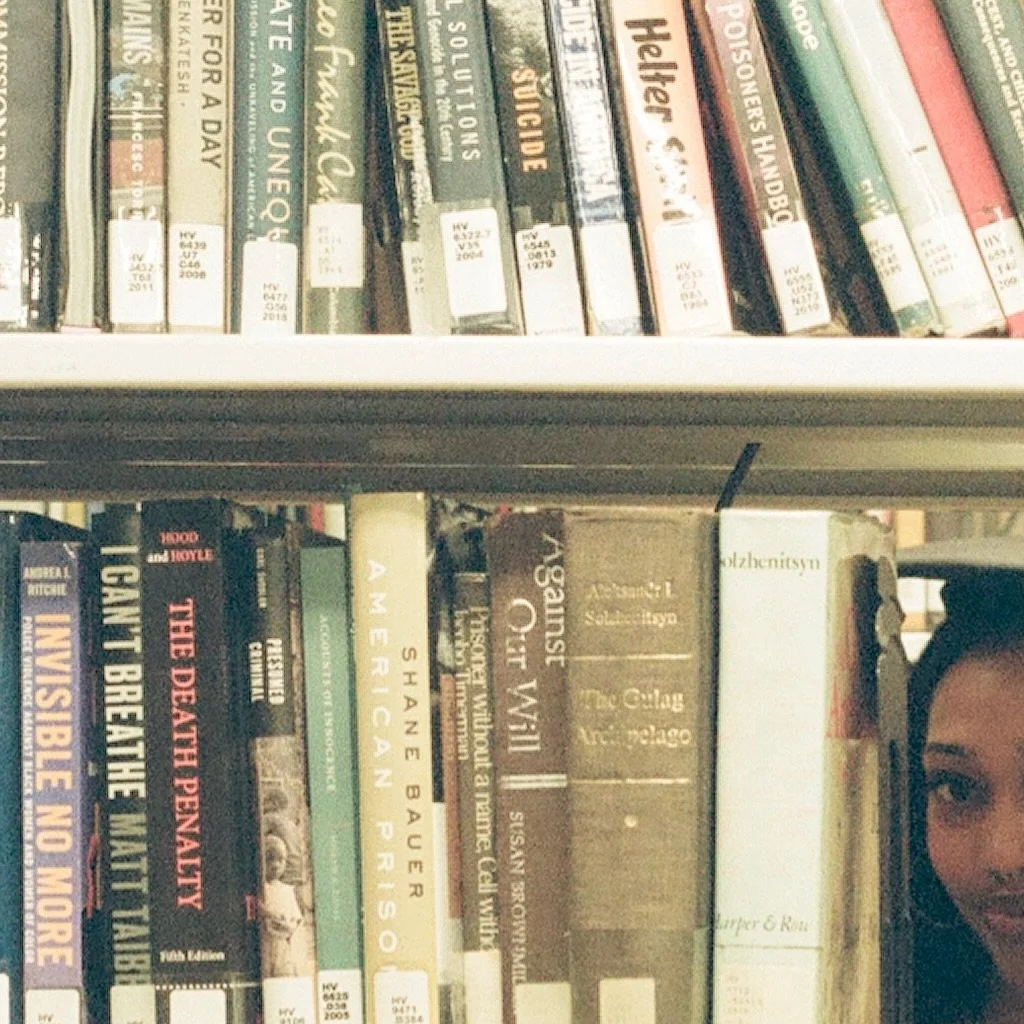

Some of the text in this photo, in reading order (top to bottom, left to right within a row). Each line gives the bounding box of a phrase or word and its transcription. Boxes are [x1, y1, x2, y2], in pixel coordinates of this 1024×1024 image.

[268, 0, 293, 52] ATE
[385, 7, 414, 47] THE
[200, 34, 224, 169] FOR A DAY
[270, 62, 287, 114] AND
[449, 21, 480, 161] SOLUTIONS
[624, 17, 679, 123] Helter
[510, 67, 547, 173] SUICIDE
[717, 3, 793, 227] POISONER'S HANDBO
[179, 231, 196, 240] HV
[263, 282, 281, 292] HV
[147, 549, 213, 564] and HOYLE
[160, 531, 200, 545] HOOD
[720, 551, 820, 576] olzhenitsyn
[24, 566, 62, 580] ANDREA
[27, 583, 67, 597] RITCHIE
[533, 532, 566, 668] Against
[100, 545, 147, 800] I CAN'T BREATHE
[249, 641, 265, 703] CRIMINAL
[266, 637, 285, 705] PRESUMED
[506, 598, 542, 754] Our Will
[622, 688, 685, 712] Gulag
[168, 597, 203, 912] THE DEATH PENALTY
[367, 559, 400, 973] AMERICAN PRISO
[402, 647, 425, 899] SHANE BAUER
[469, 606, 498, 894] Prisoner without a name, Cell
[34, 613, 75, 968] INVISIBLE NO MORE
[108, 812, 149, 891] MATT
[509, 811, 526, 877] SUSAN
[160, 950, 225, 963] Fifth Edition
